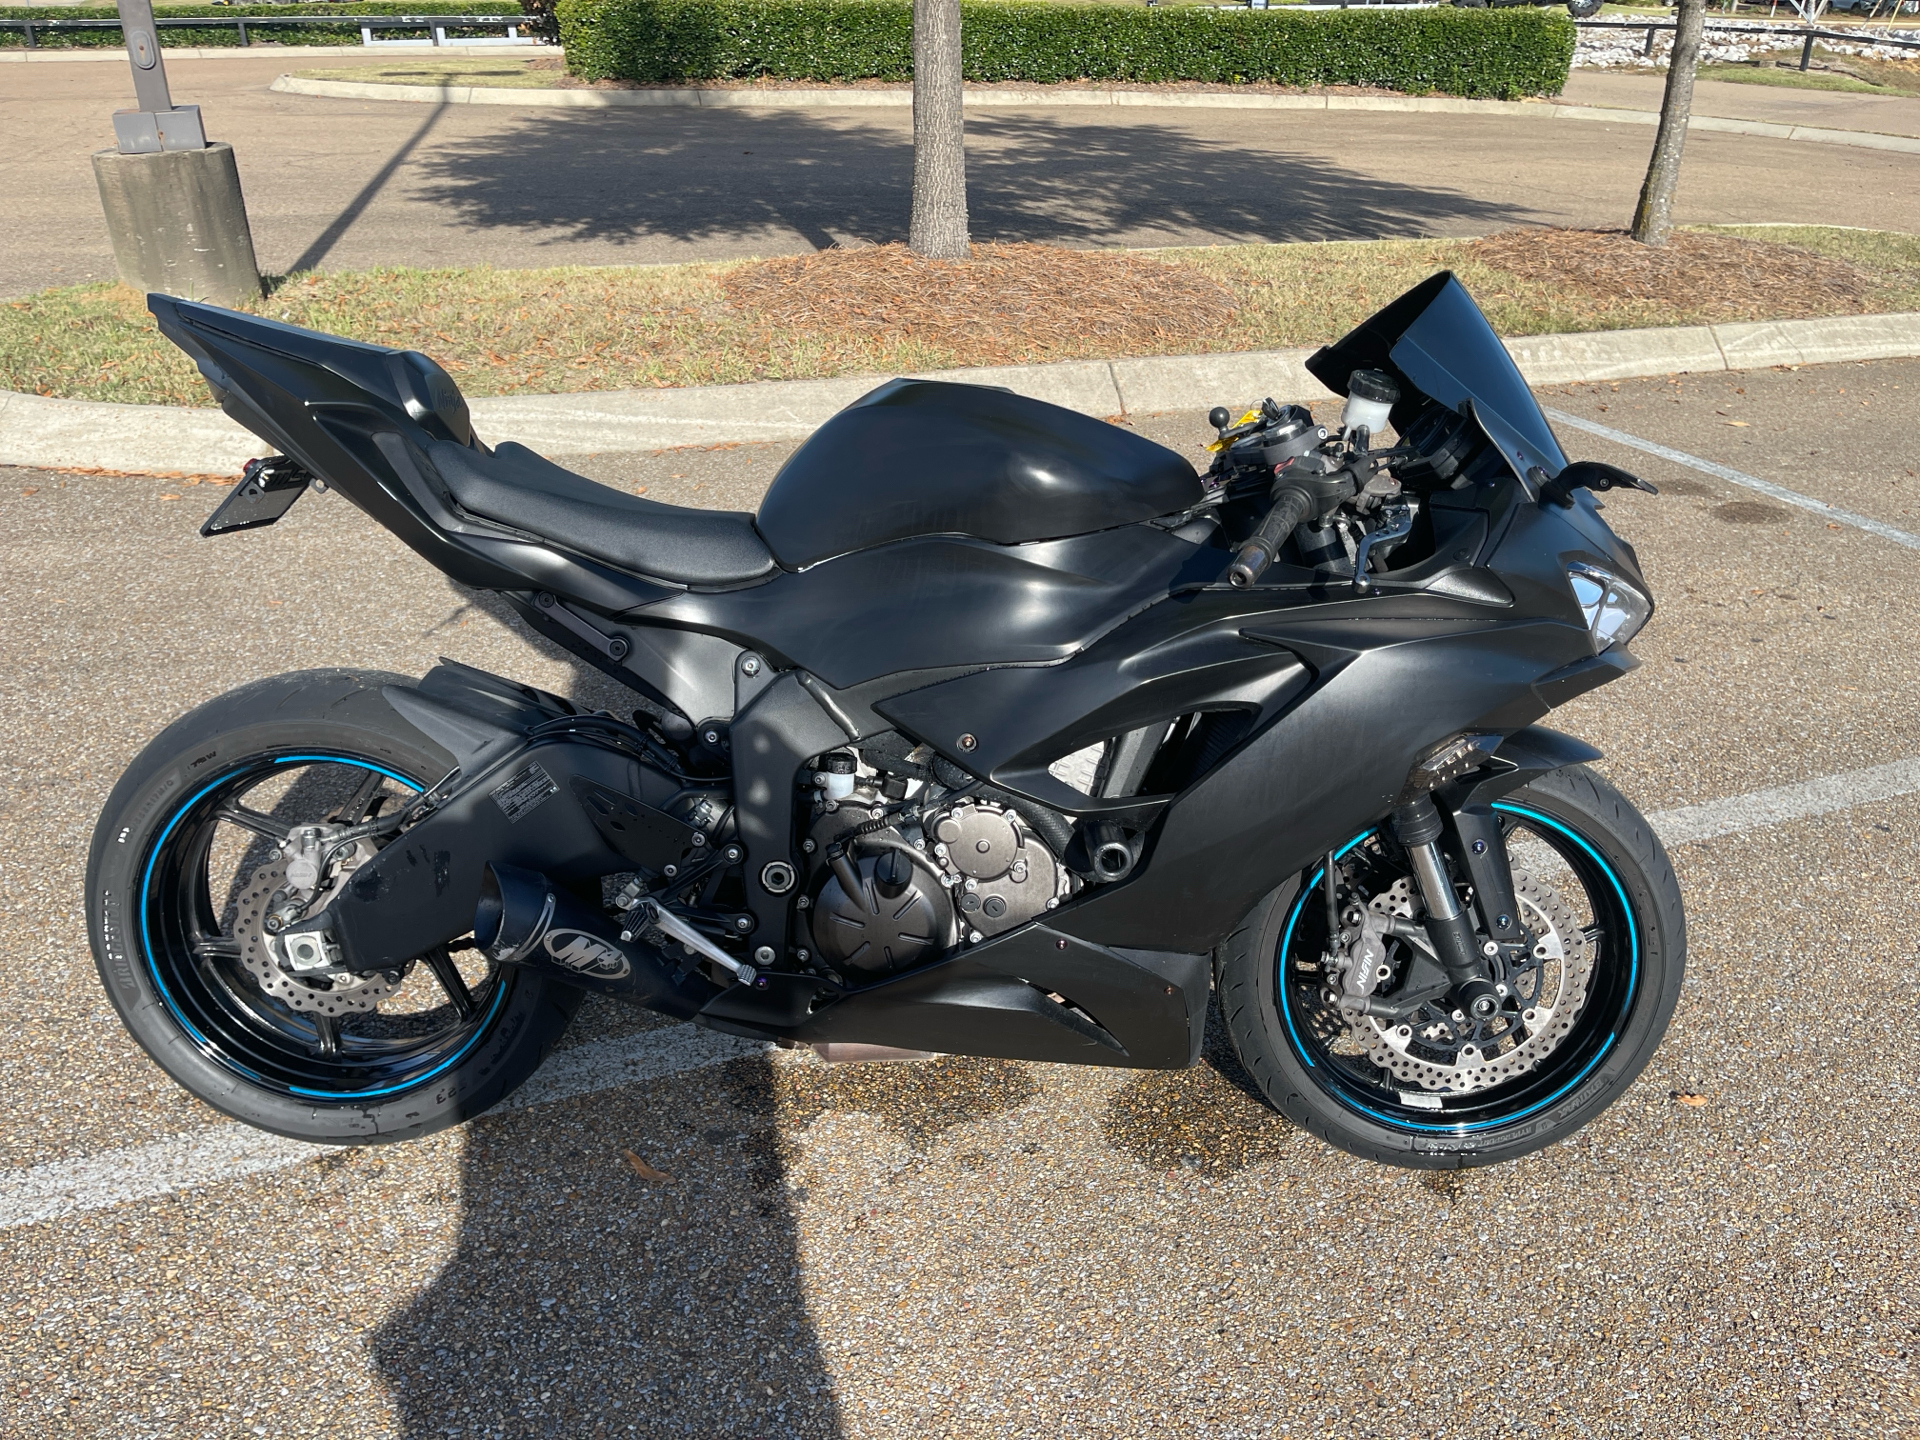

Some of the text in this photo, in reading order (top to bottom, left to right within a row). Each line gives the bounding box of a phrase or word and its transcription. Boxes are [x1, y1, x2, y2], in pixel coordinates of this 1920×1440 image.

[436, 388, 464, 414] Ninja
[551, 936, 623, 973] M4
[1356, 948, 1374, 995] NISSIN
